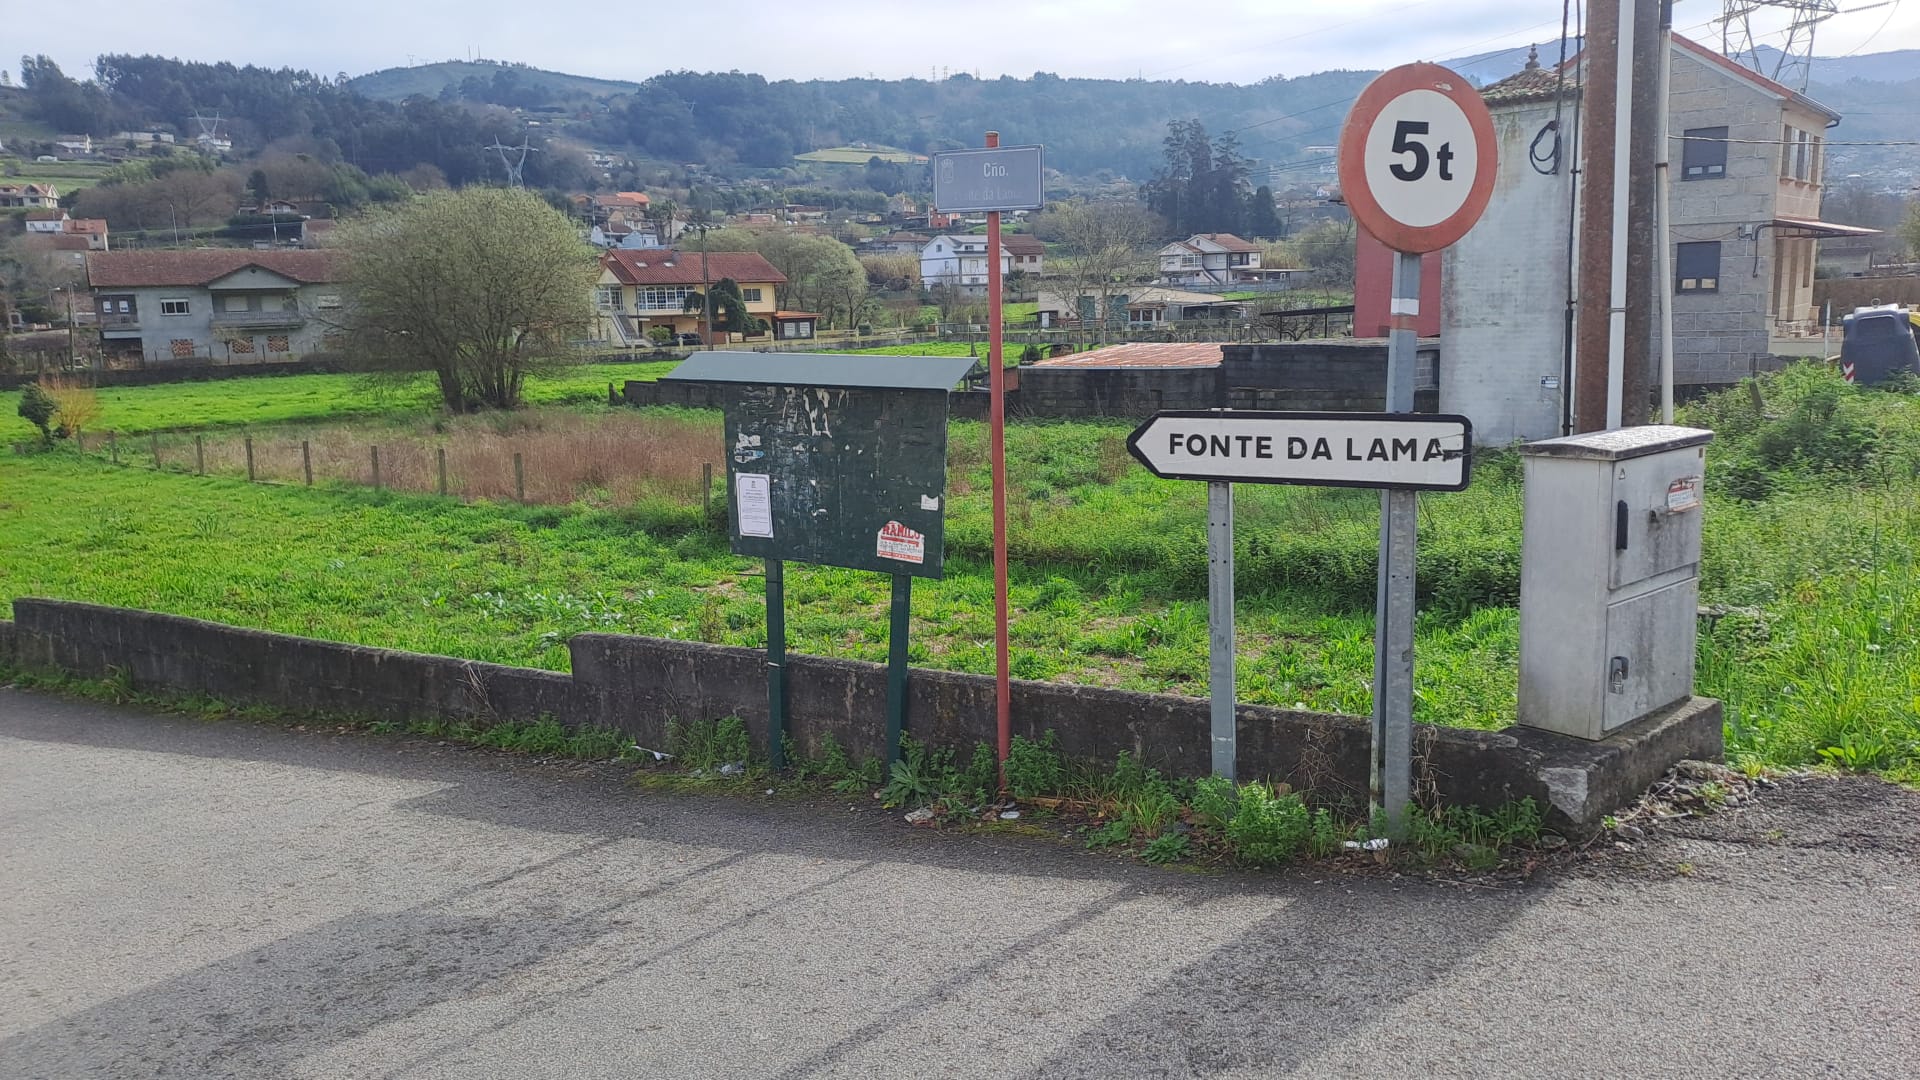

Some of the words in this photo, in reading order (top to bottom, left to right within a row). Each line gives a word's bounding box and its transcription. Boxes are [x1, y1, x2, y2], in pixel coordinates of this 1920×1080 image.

[983, 162, 1009, 178] Cño.
[1169, 433, 1273, 459] FONTE
[1287, 437, 1332, 461] DA
[1346, 438, 1445, 462] LAMA
